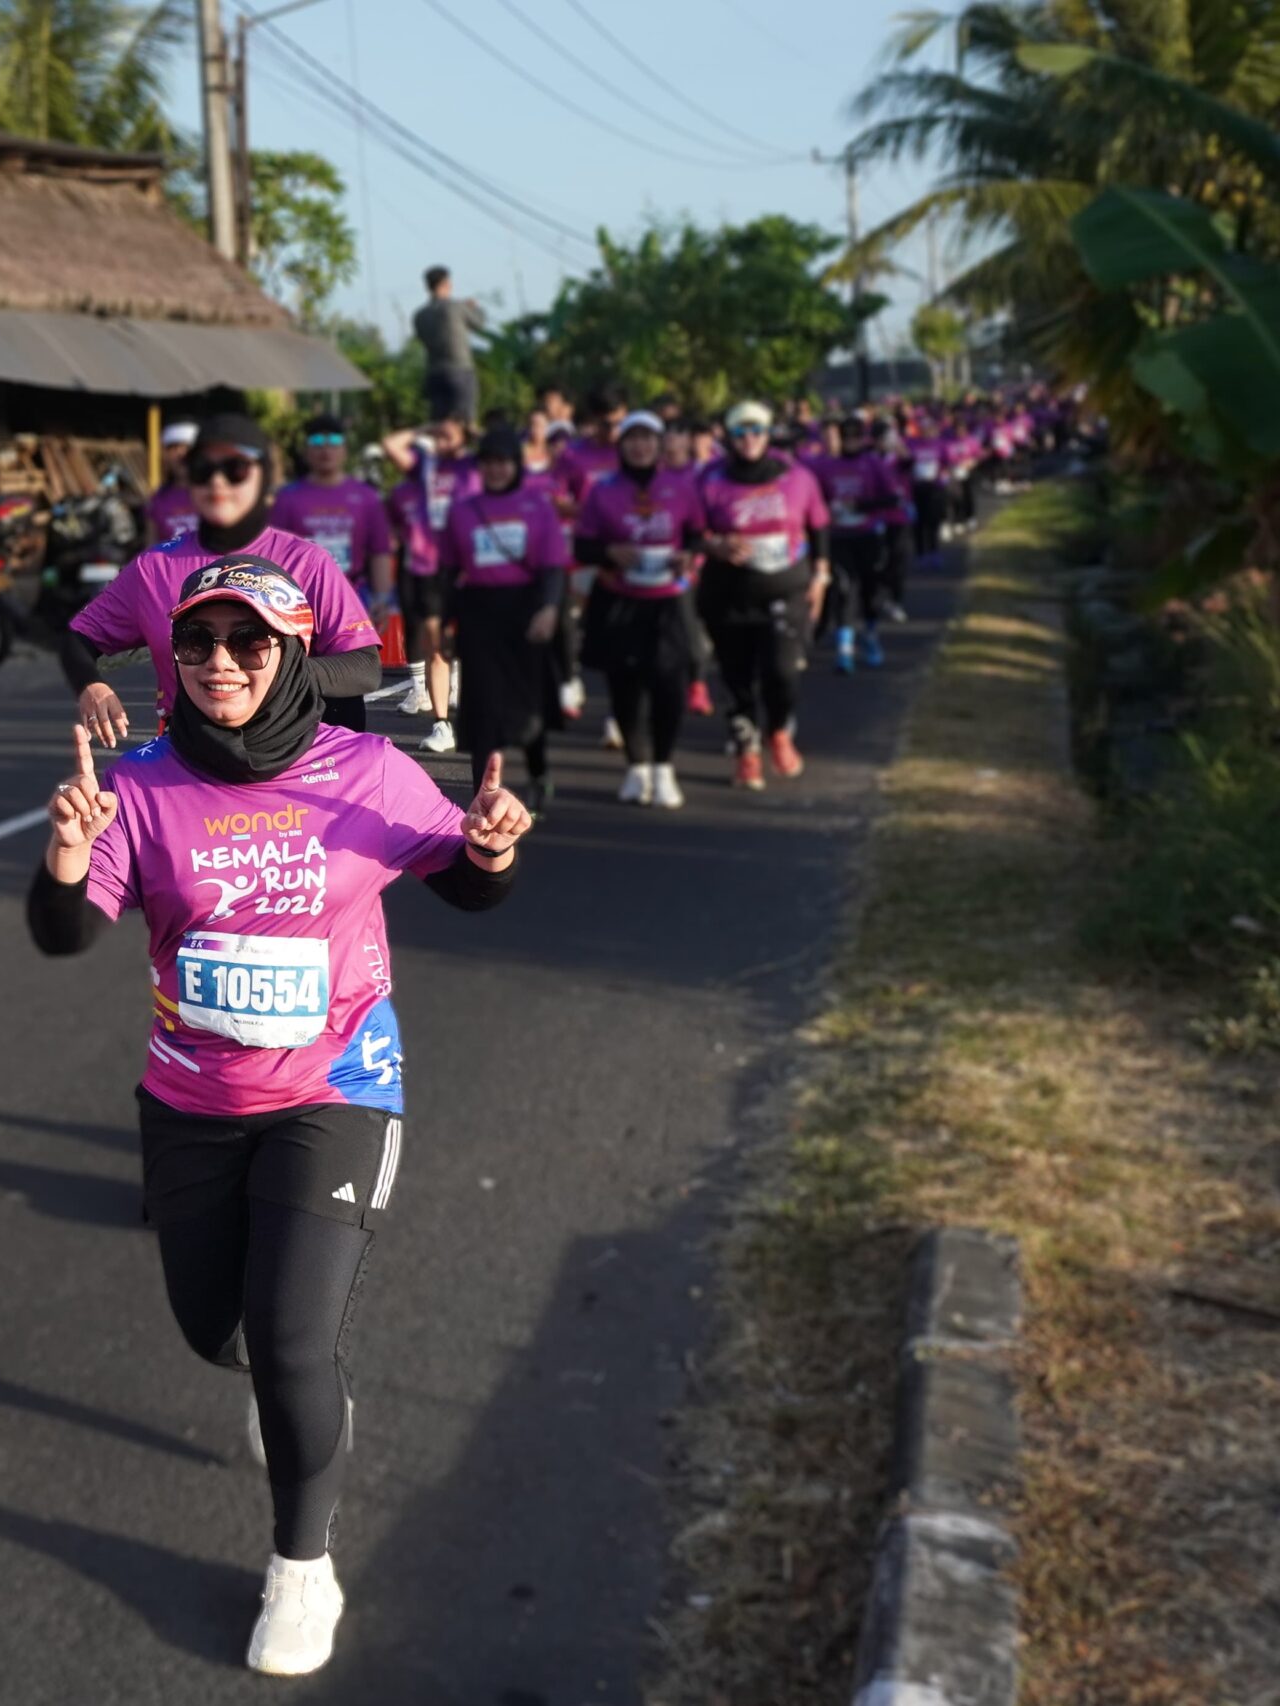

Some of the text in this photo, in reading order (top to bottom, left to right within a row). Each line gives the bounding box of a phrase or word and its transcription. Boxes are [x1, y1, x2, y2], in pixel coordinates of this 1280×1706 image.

[223, 578, 276, 596] RUNNERS
[301, 769, 340, 784] Kemala
[203, 803, 309, 836] wondr
[191, 836, 327, 872] KEMALA
[261, 865, 326, 893] RUN
[255, 888, 327, 916] 2026
[190, 940, 205, 948] 5K
[363, 943, 392, 997] BALI
[184, 961, 321, 1013] E 10554
